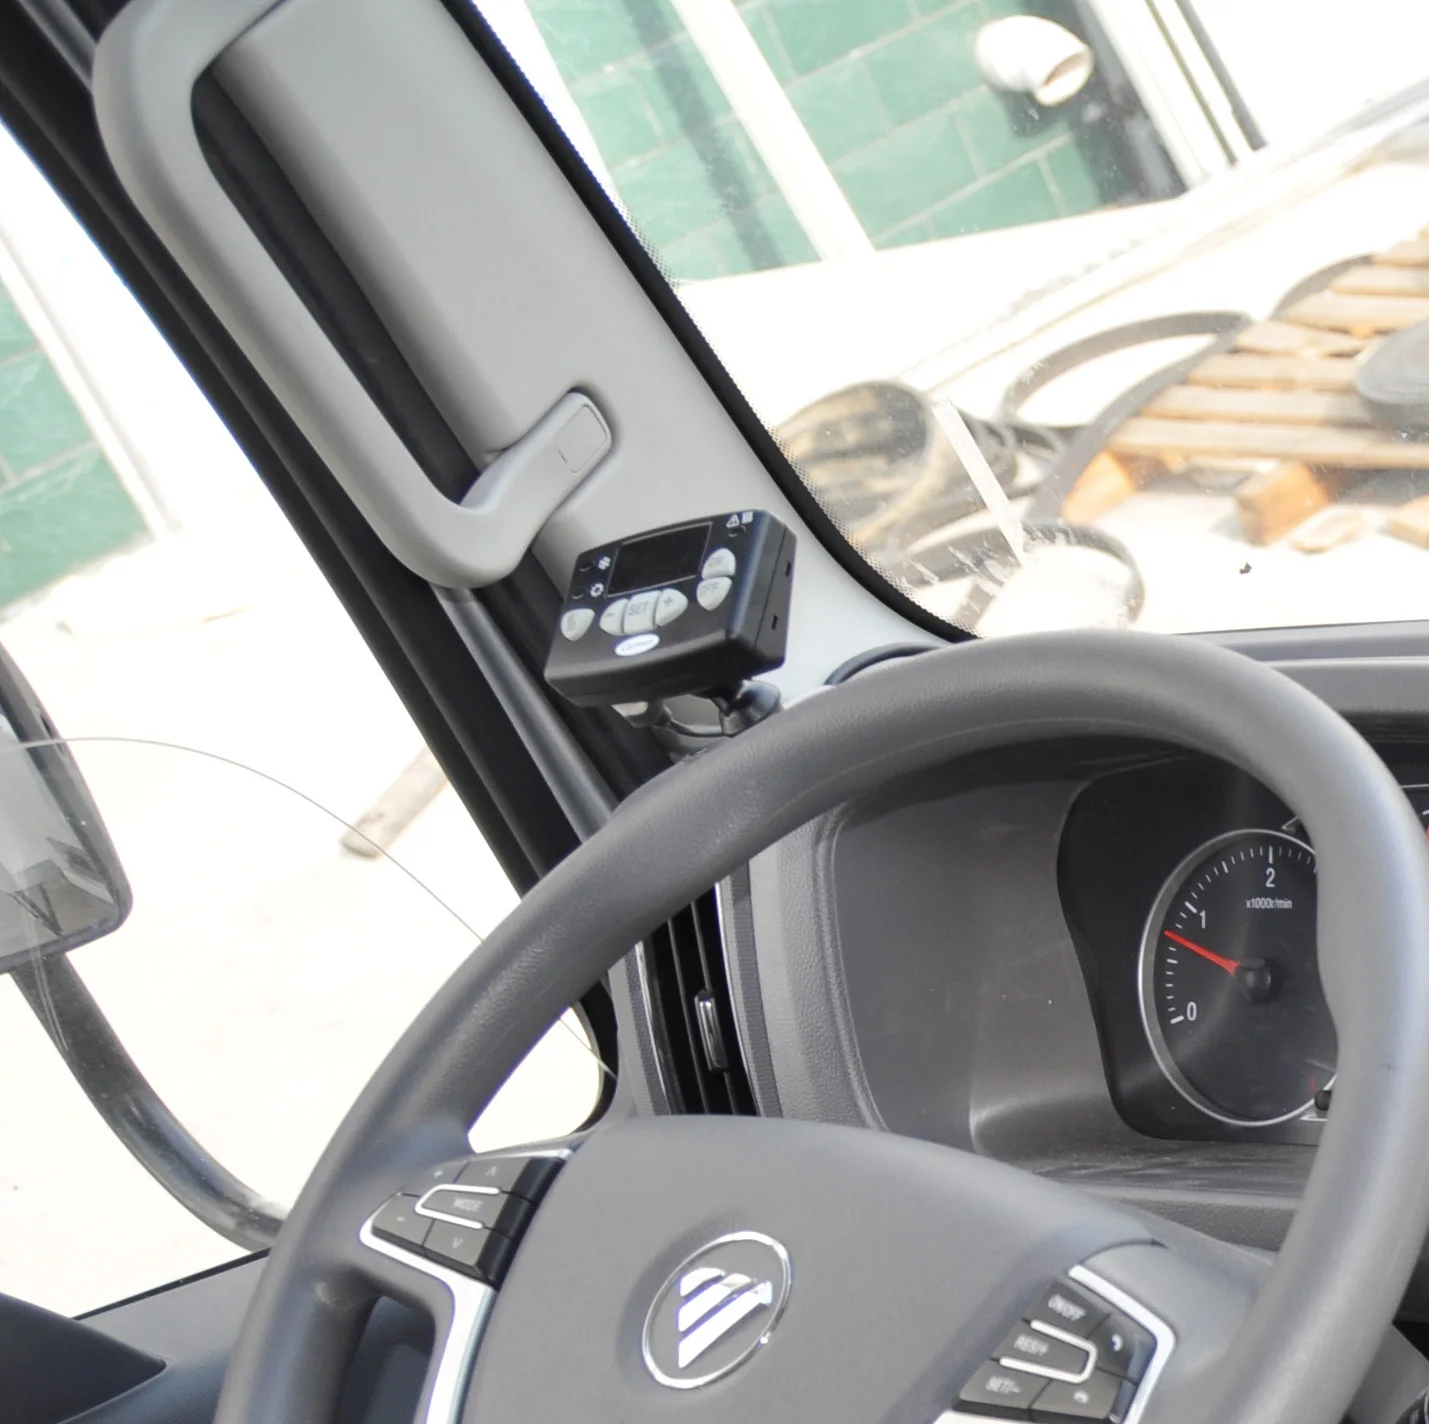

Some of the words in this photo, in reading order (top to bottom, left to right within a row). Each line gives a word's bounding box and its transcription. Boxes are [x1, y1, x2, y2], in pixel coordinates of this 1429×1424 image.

[1265, 868, 1275, 888] 2
[1199, 910, 1206, 928] 1
[1187, 1001, 1197, 1021] 0
[453, 1197, 484, 1212] MODE
